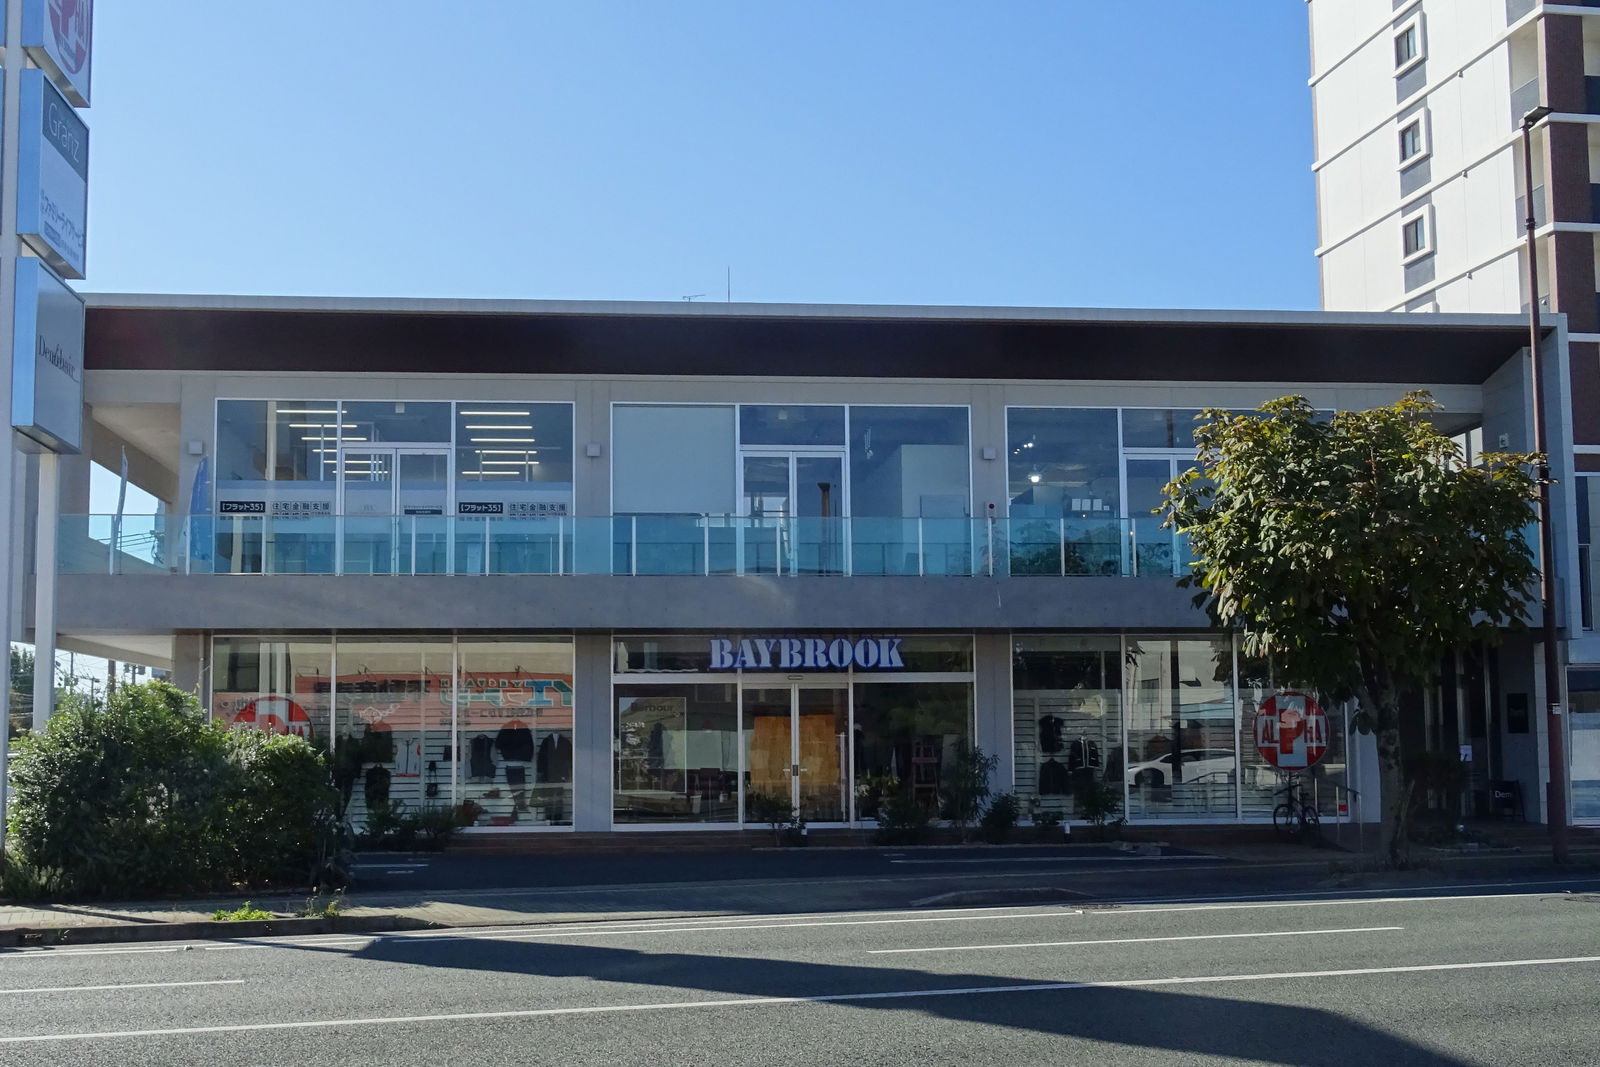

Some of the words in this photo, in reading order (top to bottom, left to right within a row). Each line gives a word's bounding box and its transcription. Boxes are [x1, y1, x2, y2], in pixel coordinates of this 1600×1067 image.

[48, 102, 80, 163] Granz
[709, 638, 905, 669] BAYBROOK
[1262, 709, 1322, 754] ALPHA
